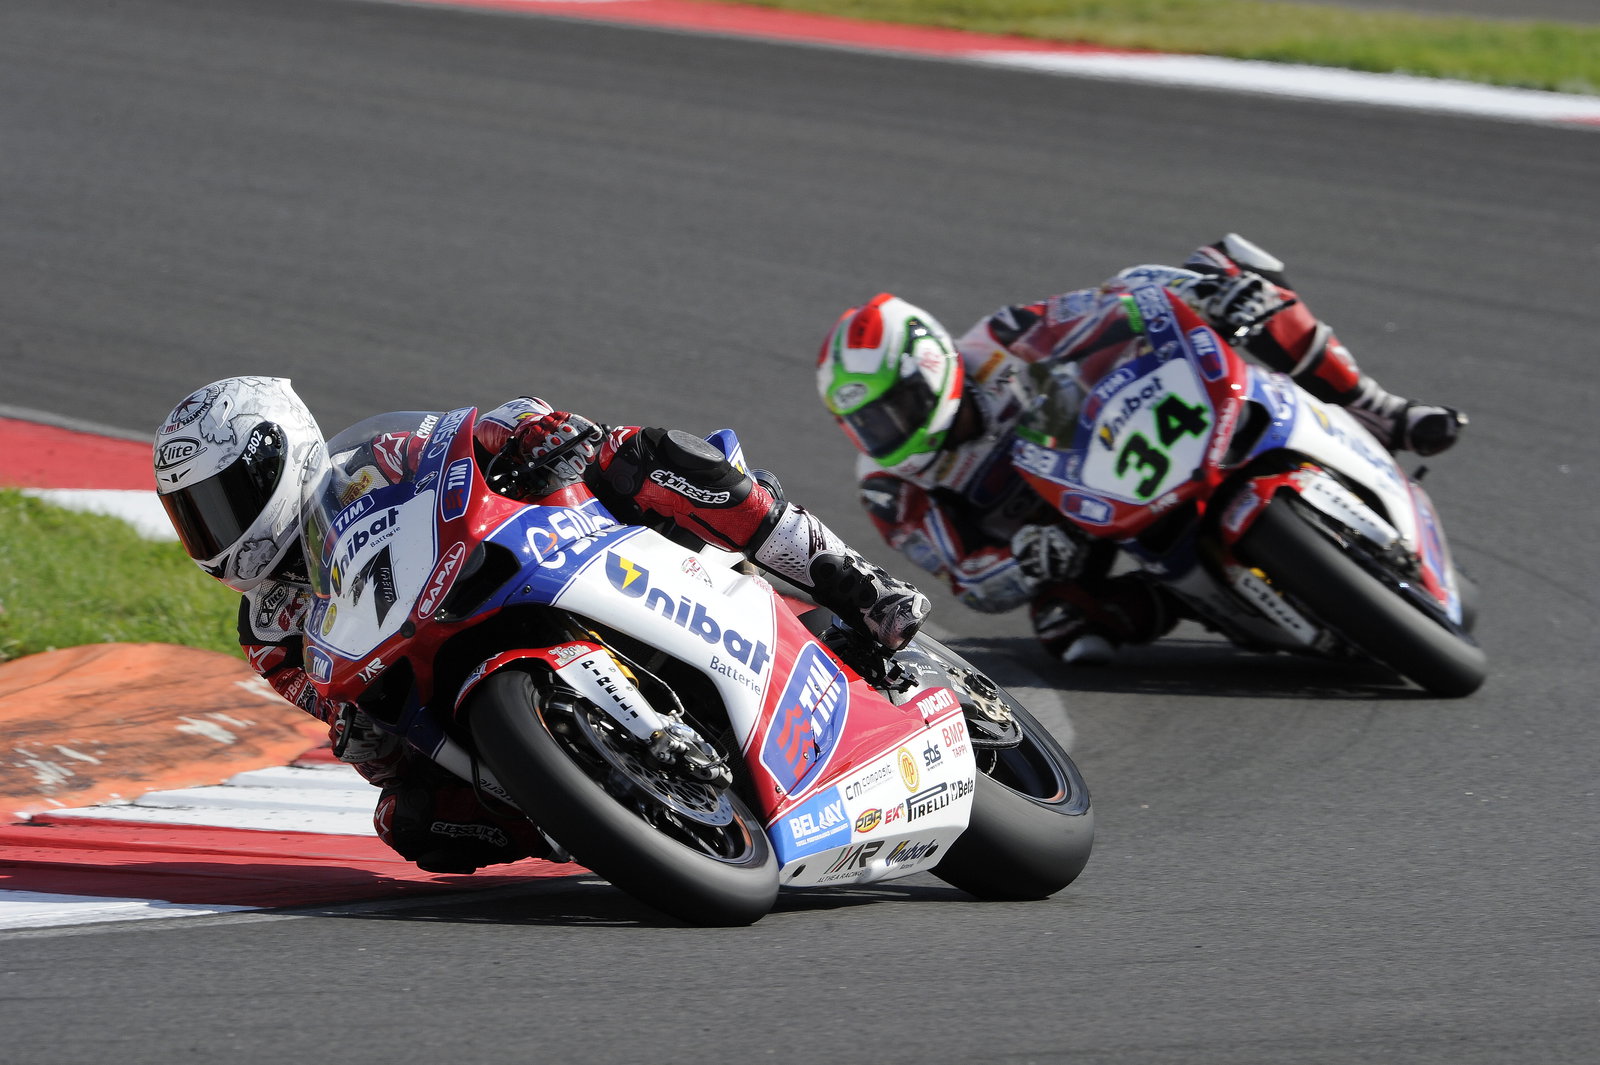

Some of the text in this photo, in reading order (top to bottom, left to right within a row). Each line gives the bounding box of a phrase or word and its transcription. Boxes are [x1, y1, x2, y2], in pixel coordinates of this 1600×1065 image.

[416, 414, 439, 439] CHECA
[241, 430, 264, 465] X-802
[1115, 393, 1210, 500] 34
[448, 463, 468, 491] TIM
[650, 468, 731, 505] alpinestars
[335, 501, 365, 532] TIM
[420, 546, 464, 615] SAPAL
[312, 656, 329, 680] TIM
[709, 655, 761, 696] Batterie
[581, 660, 639, 719] PIRELLI
[799, 654, 842, 738] TIM
[916, 688, 954, 719] DUCATI
[943, 721, 965, 748] BMP
[906, 782, 950, 823] PIRELLI
[957, 777, 974, 799] Beta
